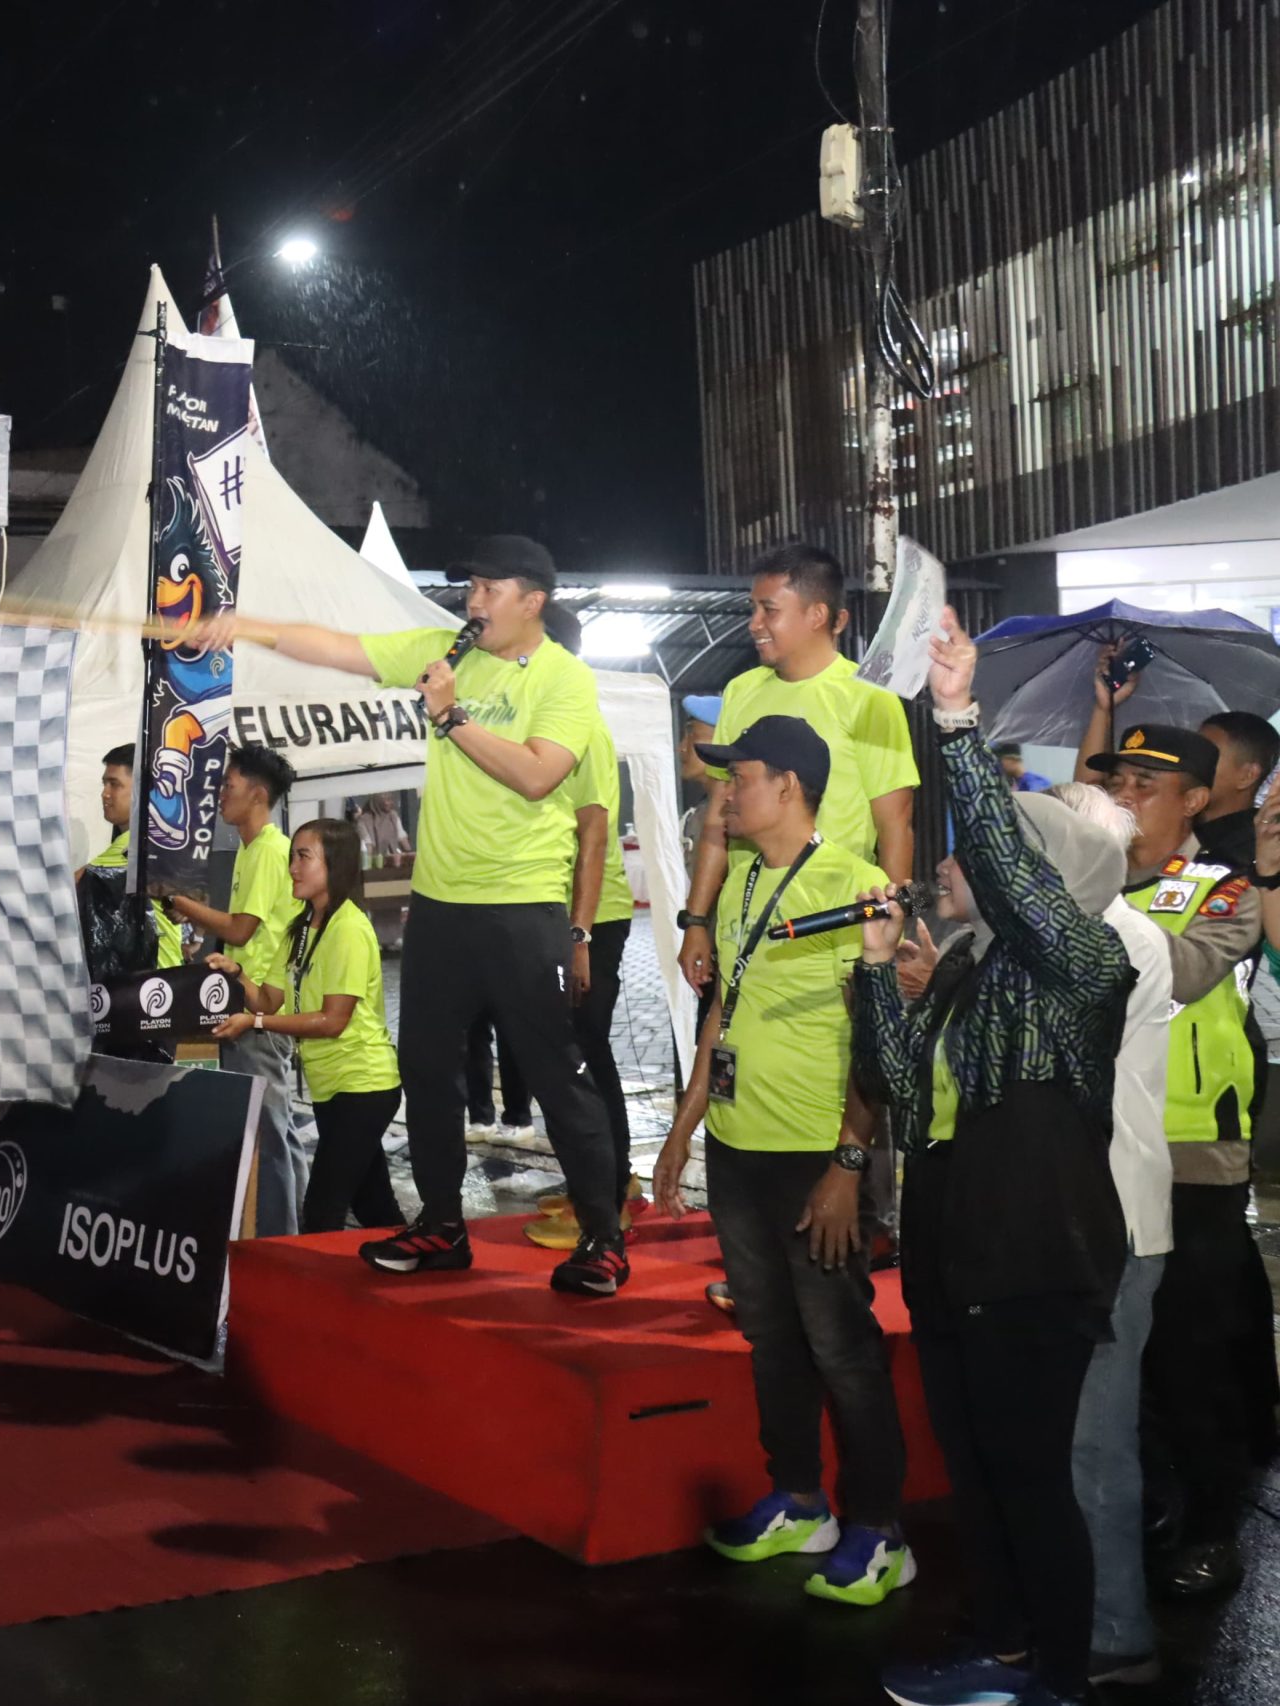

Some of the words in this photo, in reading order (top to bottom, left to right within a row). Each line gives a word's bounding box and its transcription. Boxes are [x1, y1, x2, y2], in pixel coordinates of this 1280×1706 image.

[191, 758, 222, 861] PLAYON
[140, 1018, 171, 1026] PLAYON
[58, 1202, 199, 1284] ISOPLUS
